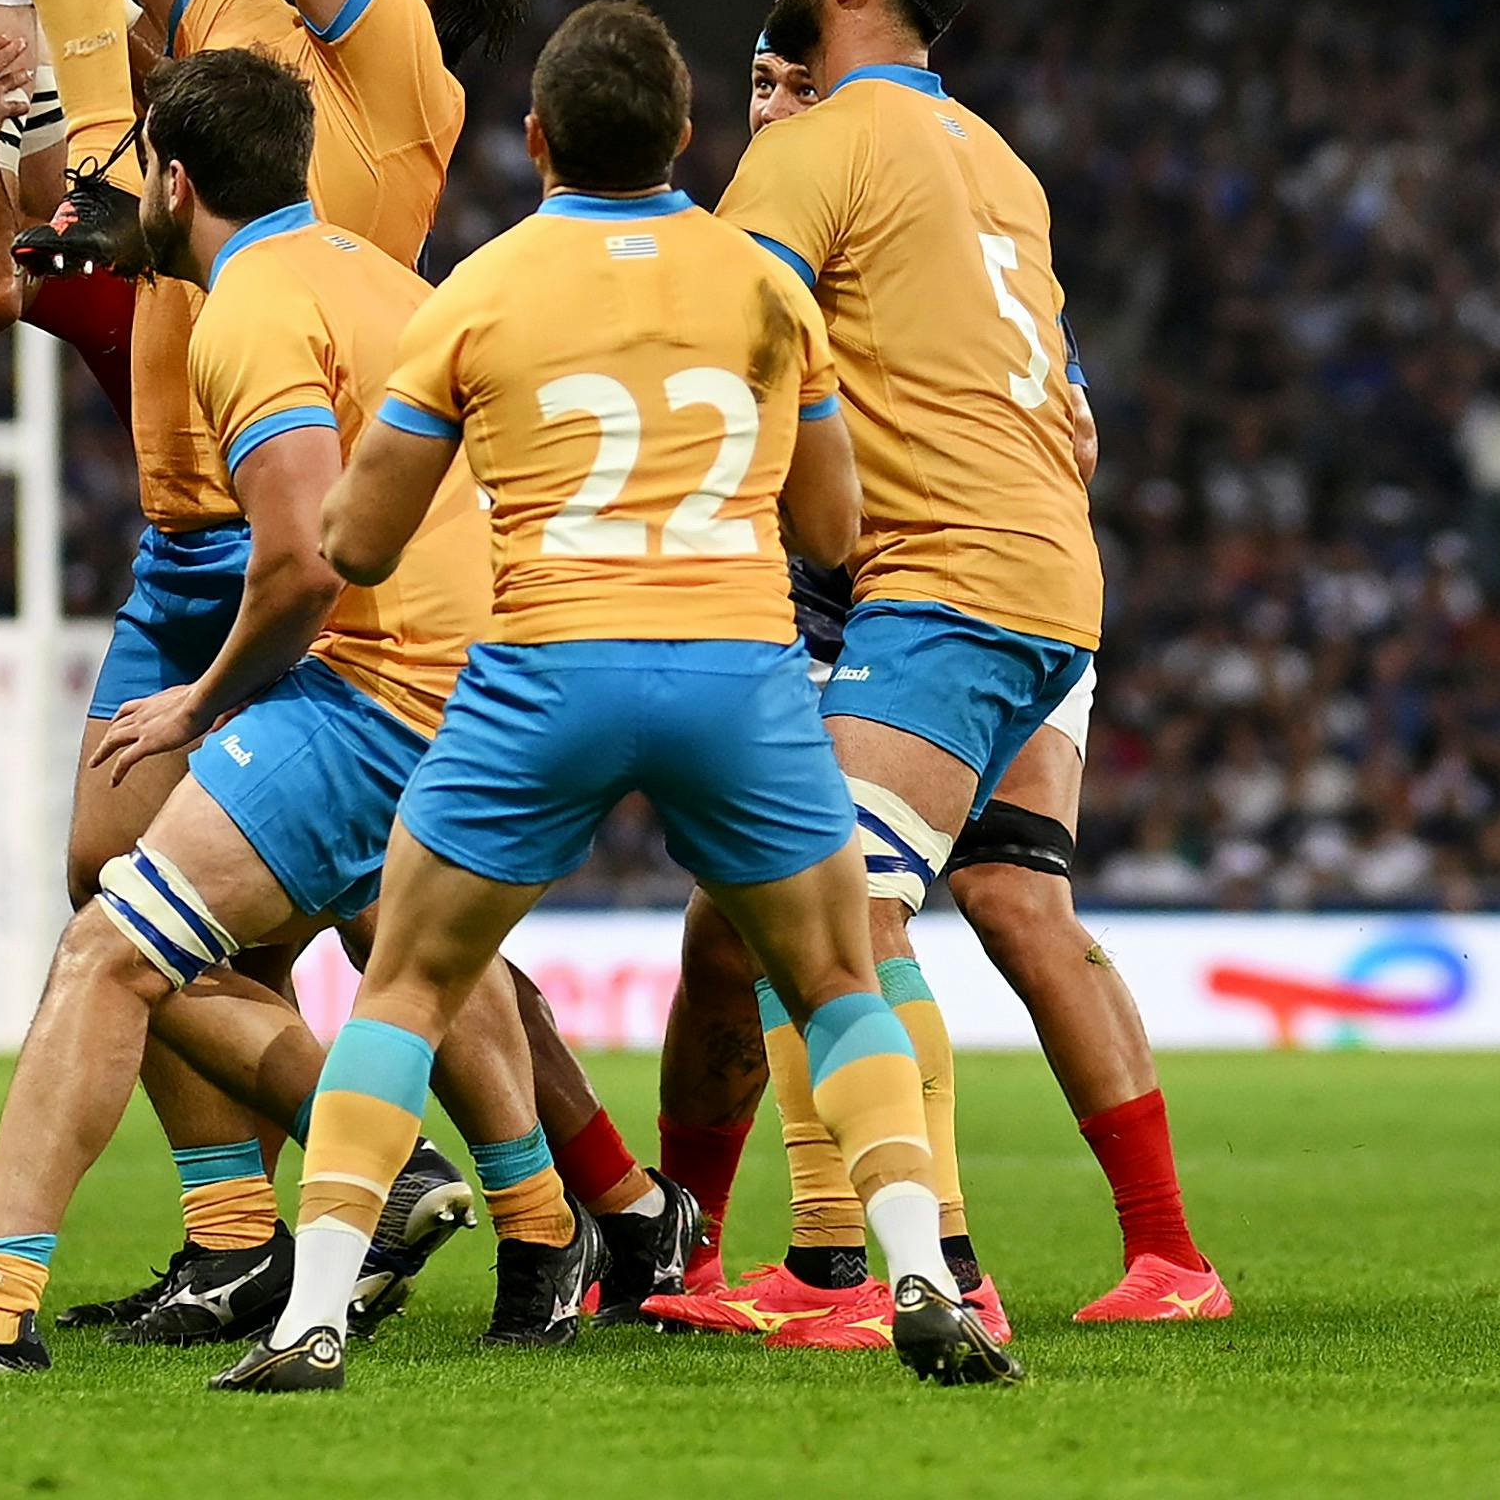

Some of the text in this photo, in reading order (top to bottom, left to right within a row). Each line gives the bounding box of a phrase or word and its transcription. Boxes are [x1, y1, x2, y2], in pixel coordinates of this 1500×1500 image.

[976, 232, 1050, 410] 5
[535, 366, 760, 556] 22
[219, 734, 253, 767] flash
